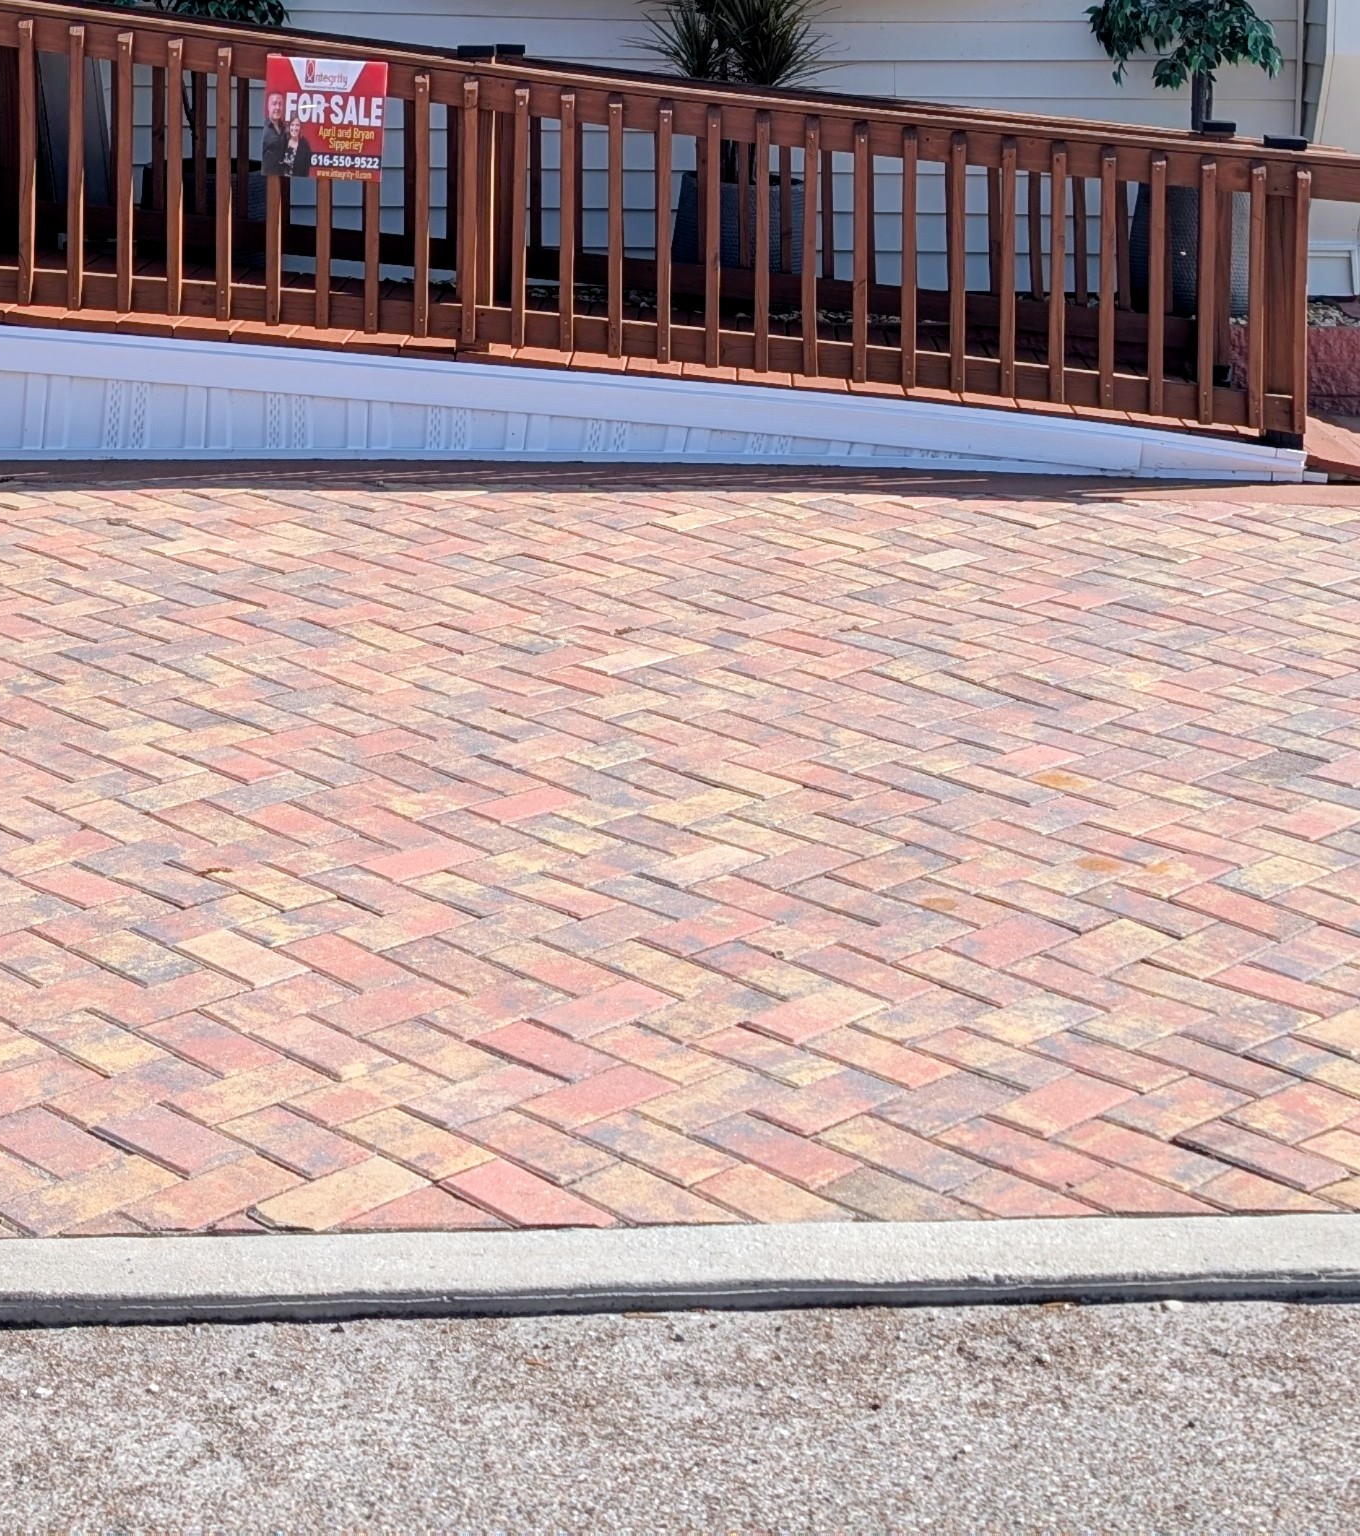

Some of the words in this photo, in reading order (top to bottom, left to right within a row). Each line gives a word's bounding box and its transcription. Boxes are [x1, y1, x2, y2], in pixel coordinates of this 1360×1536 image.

[284, 92, 327, 124] FOR
[329, 94, 383, 126] SALE
[318, 125, 336, 140] April
[337, 126, 352, 139] and
[353, 127, 375, 141] Bryan
[310, 153, 380, 169] 616-550-9522
